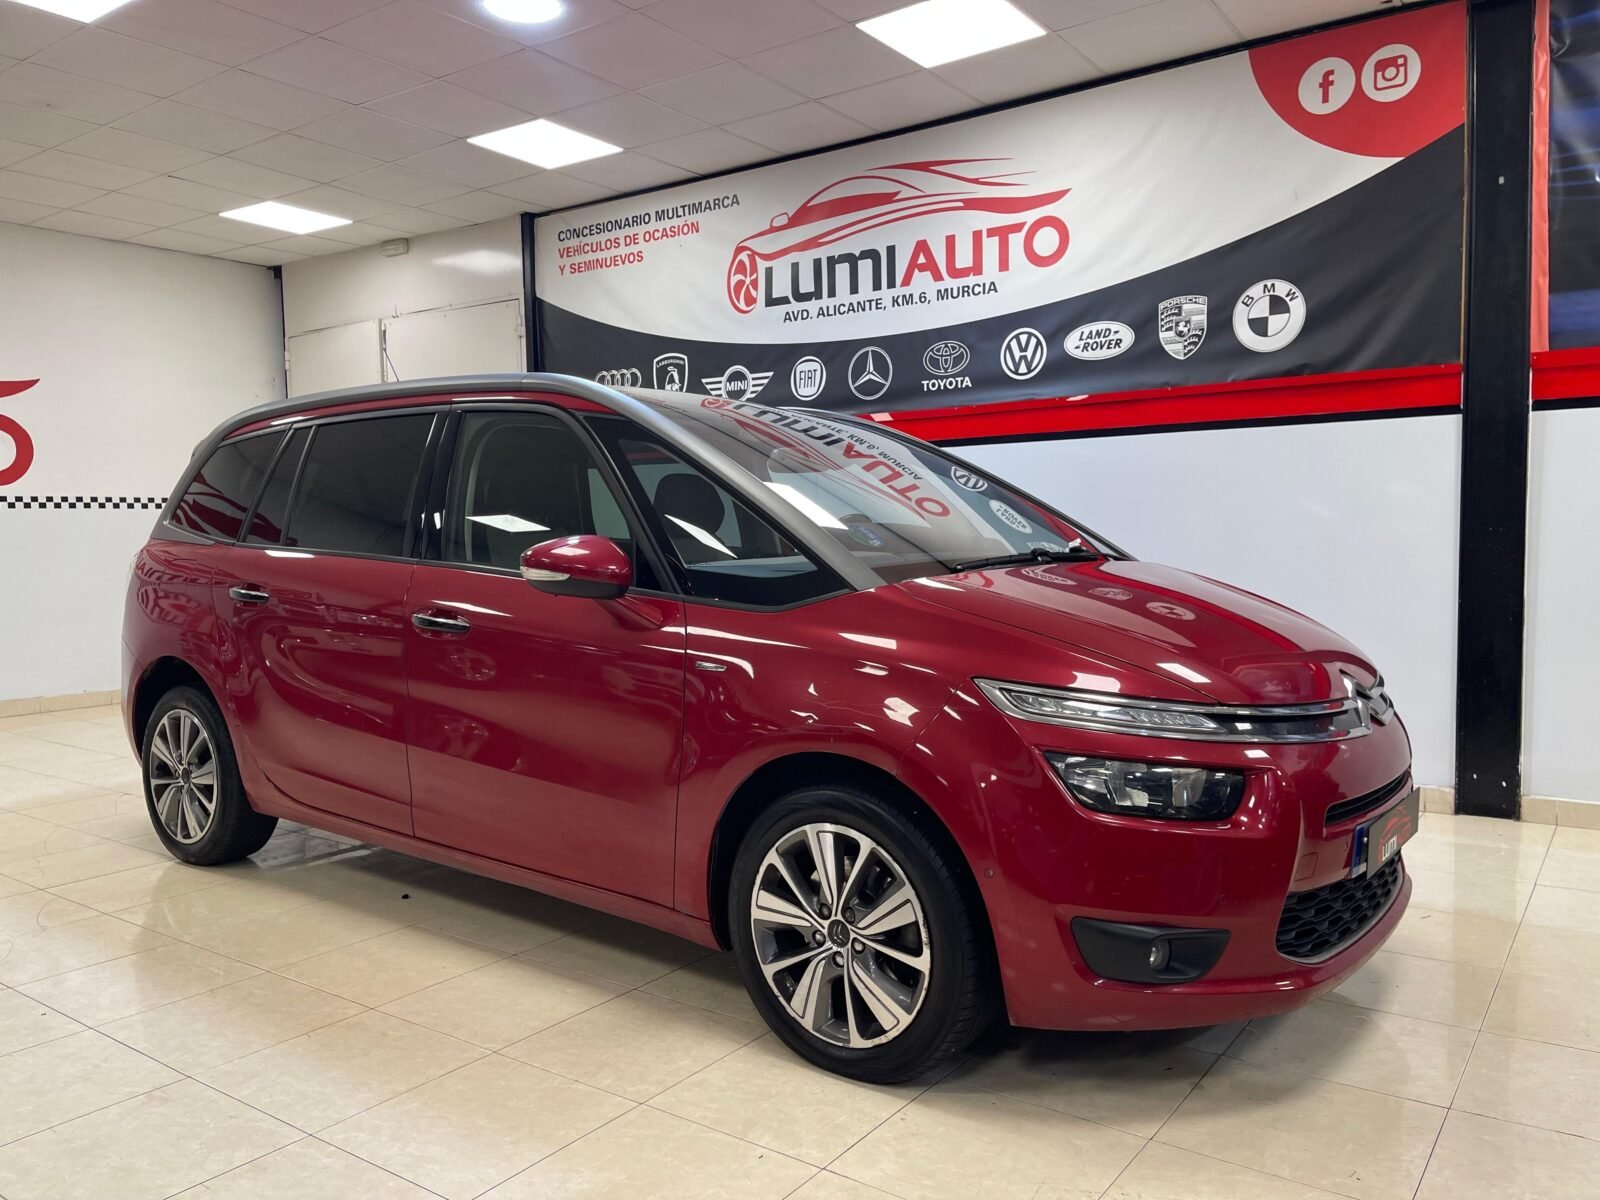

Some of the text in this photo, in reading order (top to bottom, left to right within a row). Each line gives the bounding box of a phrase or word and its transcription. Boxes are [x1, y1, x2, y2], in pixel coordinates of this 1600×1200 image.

[557, 194, 740, 242] CONCESIONARIO MULTIMARCA
[558, 220, 700, 259] VEHÍCULOS DE OCASIÓN
[558, 250, 644, 276] Y SEMINUEVOS
[783, 281, 998, 323] AVD. ALICANTE, KM.6, MURCIA
[1160, 296, 1206, 311] PORSCHE
[1241, 283, 1299, 308] BMW
[726, 380, 748, 392] MINI
[799, 368, 818, 390] FIAT
[921, 376, 972, 392] TOYOTA
